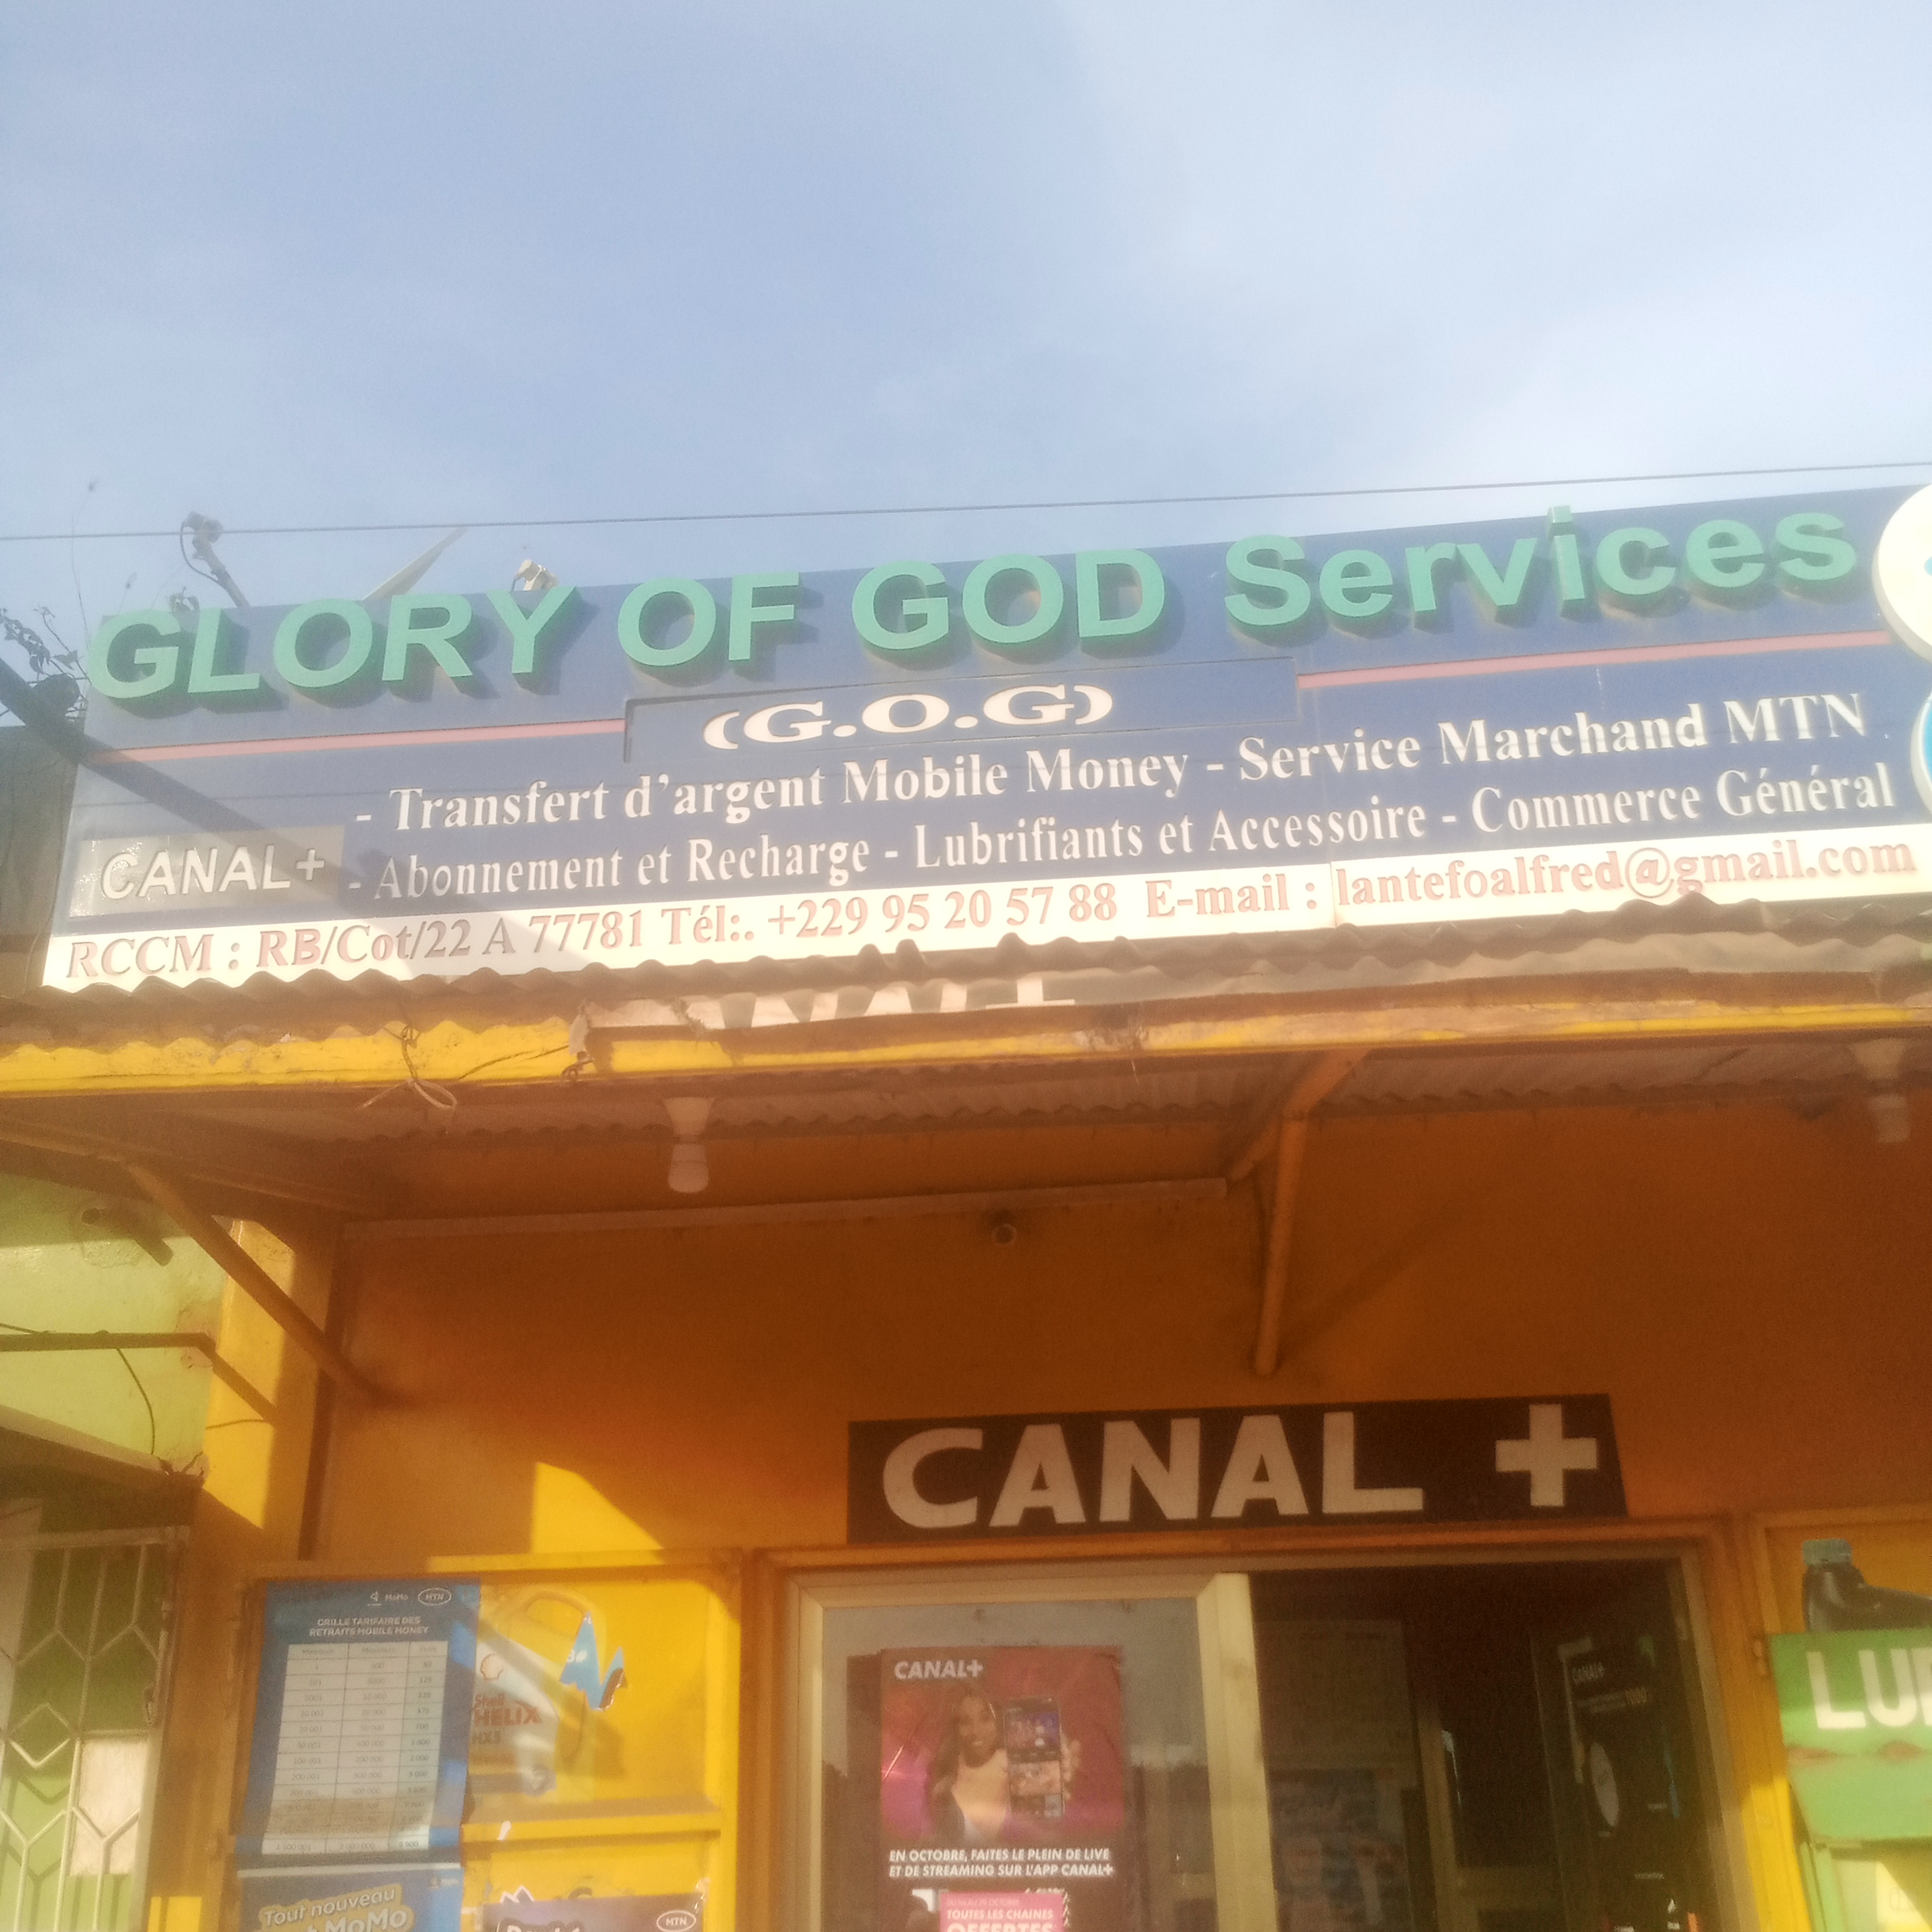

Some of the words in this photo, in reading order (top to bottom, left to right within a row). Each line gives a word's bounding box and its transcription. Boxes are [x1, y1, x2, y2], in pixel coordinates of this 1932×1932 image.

[87, 585, 584, 701] GLORY
[617, 572, 800, 668] OF
[851, 548, 1165, 651] GOD
[1224, 505, 1858, 627] Services
[703, 683, 1113, 750] (G.O.G)
[389, 779, 609, 831] Transfert
[624, 771, 825, 823] d'argent
[843, 754, 1008, 805] Mobile
[1026, 747, 1188, 797] Money
[1239, 727, 1422, 781] Service
[1438, 703, 1707, 766] Marchand
[1722, 693, 1866, 744] MTN
[374, 848, 622, 899] Abonnement
[638, 846, 670, 884] et
[687, 835, 870, 886] Recharge
[915, 816, 1143, 869] Lubrifiants
[1159, 812, 1194, 855] et
[1208, 795, 1426, 851] Accessoire
[1472, 778, 1701, 834] Commerce
[1717, 762, 1896, 817] Général
[100, 846, 325, 899] CANAL+
[67, 934, 213, 978] RCCM
[256, 919, 471, 968] RB/Cot/22
[482, 918, 515, 955] A
[528, 909, 644, 955] 77781
[768, 896, 869, 940] +229
[882, 893, 931, 934] 95
[944, 889, 992, 929] 20
[1006, 886, 1054, 926] 57
[1069, 882, 1118, 922] 88
[1145, 873, 1290, 918] E-mail
[1337, 839, 1916, 907] lantefoalfred@gmail.com
[882, 1411, 1424, 1529] CANAL
[426, 1593, 444, 1601] MTN
[309, 1627, 355, 1636] RETRAITS
[357, 1626, 392, 1635] MOBILE
[395, 1625, 428, 1634] MONEY
[317, 1618, 350, 1626] GRILLE
[352, 1617, 401, 1626] TARIFAIRE
[402, 1616, 421, 1625] DES
[894, 1658, 983, 1680] CANAL+
[474, 1702, 542, 1726] HELIX
[889, 1850, 905, 1862] EN
[909, 1849, 968, 1863] OCTOBRE,
[972, 1849, 1008, 1862] FAITES
[1012, 1849, 1025, 1861] LE
[1028, 1848, 1062, 1861] PLEIN
[1066, 1848, 1081, 1860] DE
[1084, 1847, 1110, 1860] LIVE
[889, 1865, 902, 1878] ET
[904, 1865, 919, 1877] DE
[922, 1864, 995, 1877] STREAMING
[998, 1864, 1022, 1877] SUR
[1026, 1864, 1058, 1876] L'APP
[1061, 1863, 1114, 1876] CANAL+
[264, 1905, 306, 1925] Tout
[311, 1888, 395, 1917] nouveau
[947, 1909, 985, 1920] TOUTES
[987, 1908, 1003, 1920] LES
[665, 1916, 687, 1926] MTN
